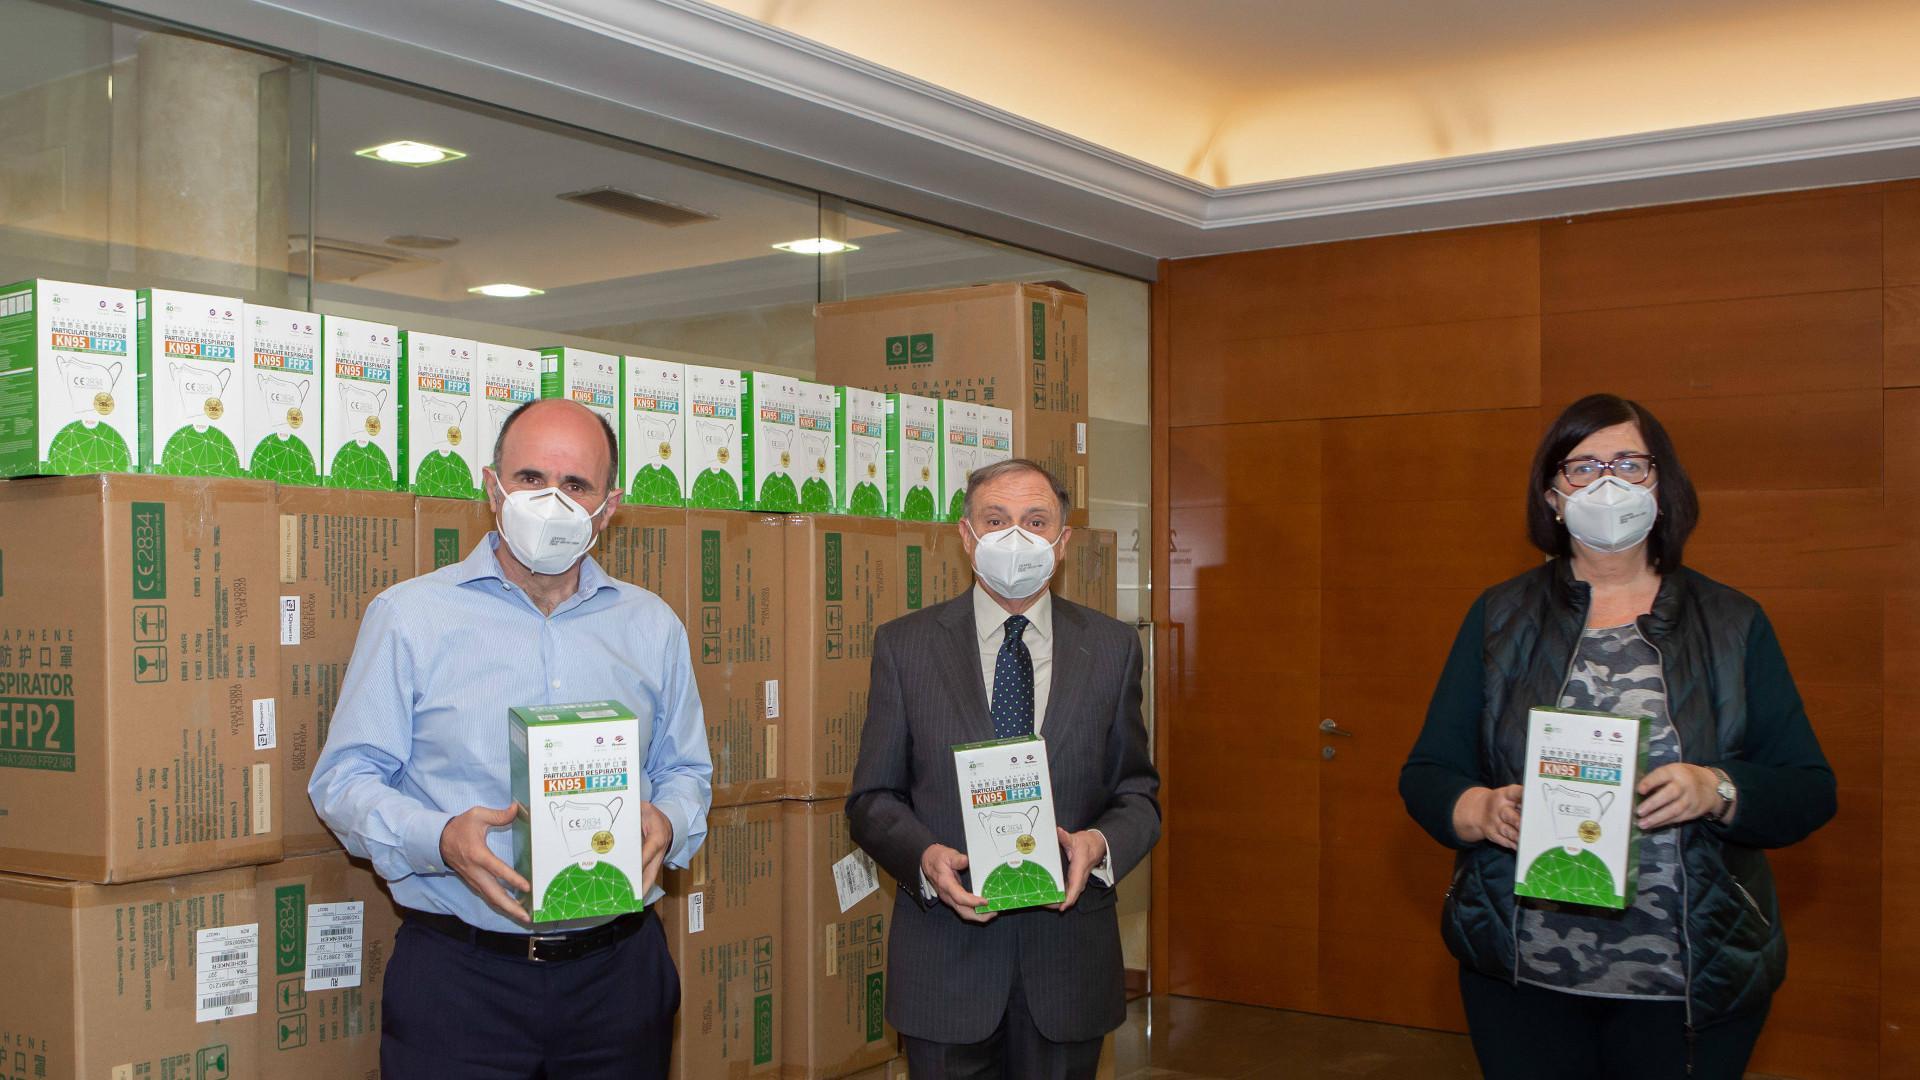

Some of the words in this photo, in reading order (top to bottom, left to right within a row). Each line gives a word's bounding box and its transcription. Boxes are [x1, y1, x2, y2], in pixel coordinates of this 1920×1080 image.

[52, 328, 89, 337] PARTICULATE
[90, 332, 126, 340] RESPIRATOR
[56, 335, 85, 348] KN95
[95, 339, 122, 352] FFP2
[165, 335, 200, 343] PARTICULATE
[201, 338, 234, 346] RESPIRATOR
[170, 342, 197, 354] KN95
[206, 346, 231, 358] FFP2
[254, 348, 284, 356] PARTICULATE
[284, 351, 313, 360] RESPIRATOR
[257, 354, 281, 366] KN95
[288, 358, 310, 371] FFP2
[336, 358, 363, 366] PARTICULATE
[339, 364, 361, 376] KN95
[368, 370, 388, 380] FFP2
[421, 378, 442, 390] KN95
[448, 382, 468, 392] FFP2
[488, 388, 509, 398] KN95
[514, 391, 532, 400] FFP2
[574, 392, 592, 401] KN95
[636, 398, 654, 408] KN95
[695, 405, 713, 414] KN95
[718, 407, 734, 416] FFP2
[136, 513, 153, 562] 2834
[704, 538, 713, 574] 2834
[827, 540, 836, 575] 2834
[1540, 756, 1580, 764] PARTICULATE
[544, 771, 584, 780] PARTICULATE
[586, 768, 627, 776] RESPIRATOR
[1544, 765, 1576, 776] KN95
[1586, 768, 1616, 780] FFP2
[549, 778, 581, 792] KN95
[592, 776, 622, 788] FFP2
[971, 786, 1004, 794] PARTICULATE
[1006, 781, 1040, 790] RESPIRATOR
[976, 793, 1003, 804] KN95
[1012, 788, 1037, 798] FFP2
[569, 820, 580, 828] CE
[280, 895, 295, 938] 2834
[212, 960, 247, 969] SCHENKER
[330, 978, 338, 987] RU
[225, 1006, 233, 1016] RU
[871, 999, 881, 1034] 2834
